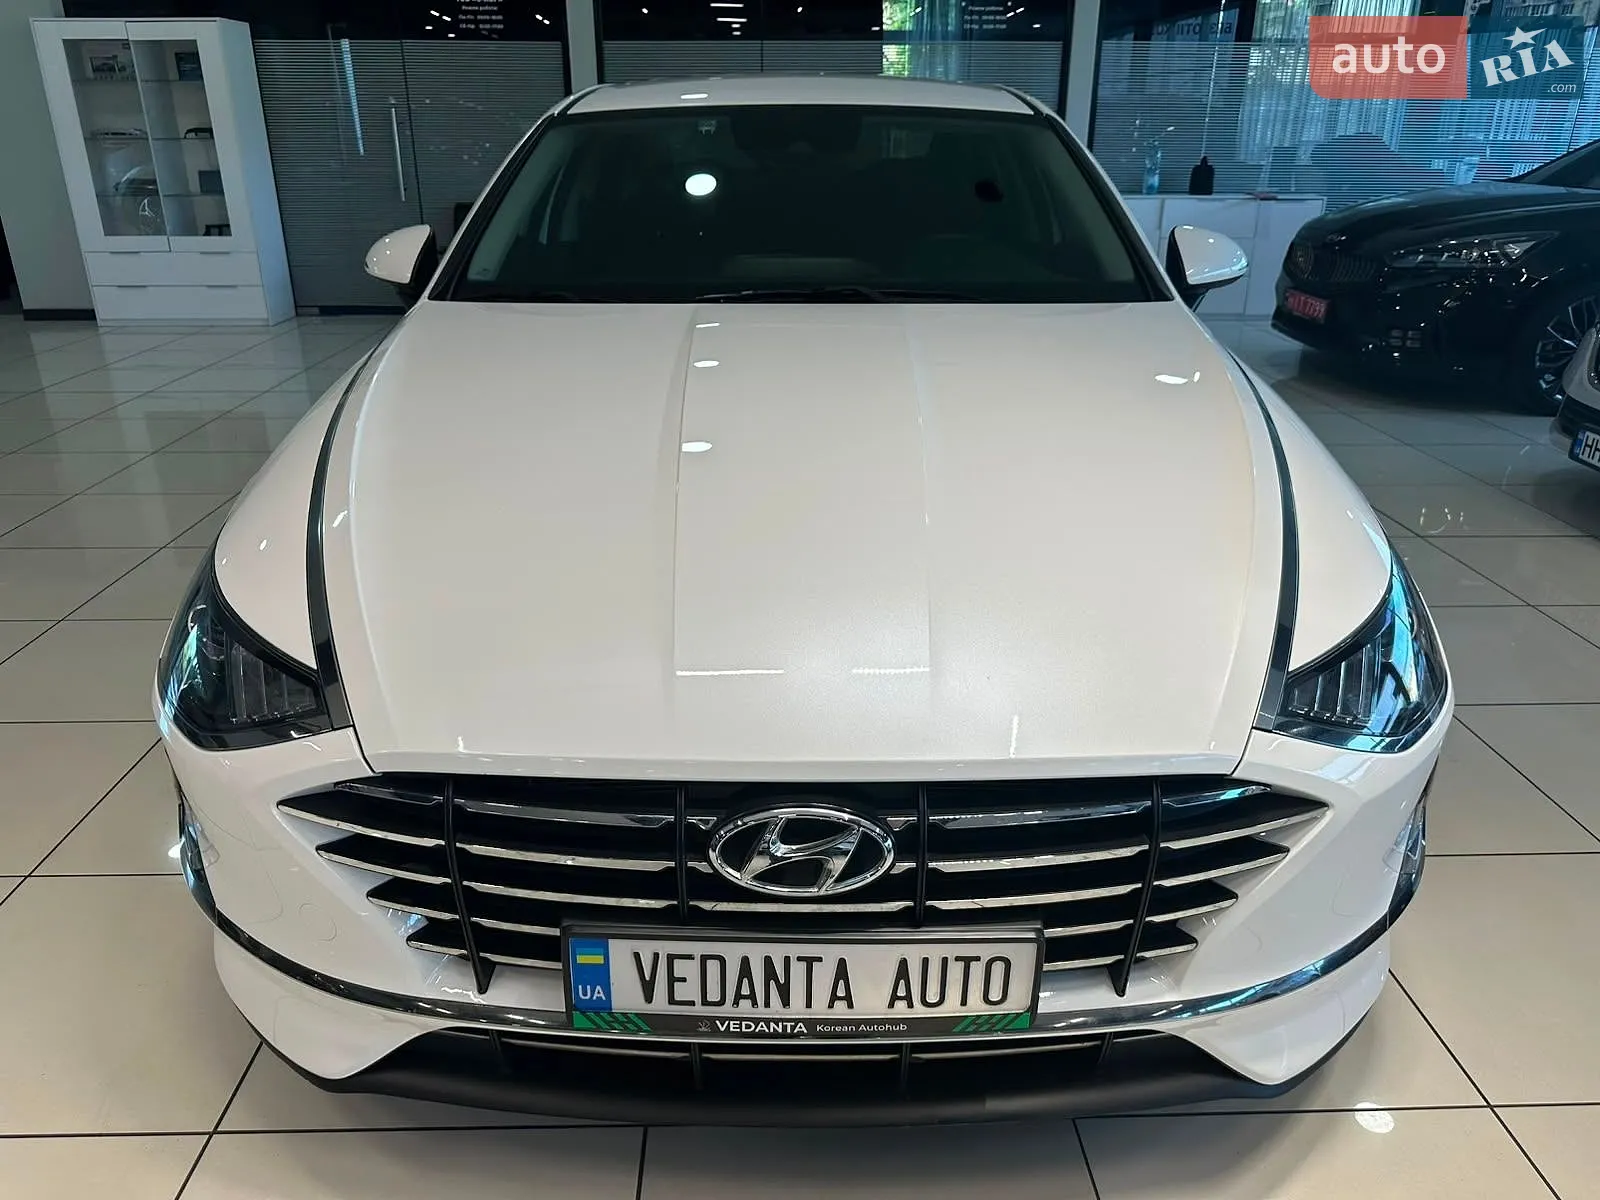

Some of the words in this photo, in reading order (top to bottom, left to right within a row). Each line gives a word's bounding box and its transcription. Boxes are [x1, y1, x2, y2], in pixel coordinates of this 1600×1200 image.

[632, 951, 855, 1009] VEDANTA
[887, 954, 1013, 1009] AUTO
[578, 984, 606, 1001] UA
[714, 1020, 808, 1034] VEDANTA
[816, 1023, 855, 1033] Korean
[859, 1022, 908, 1032] Autohub
